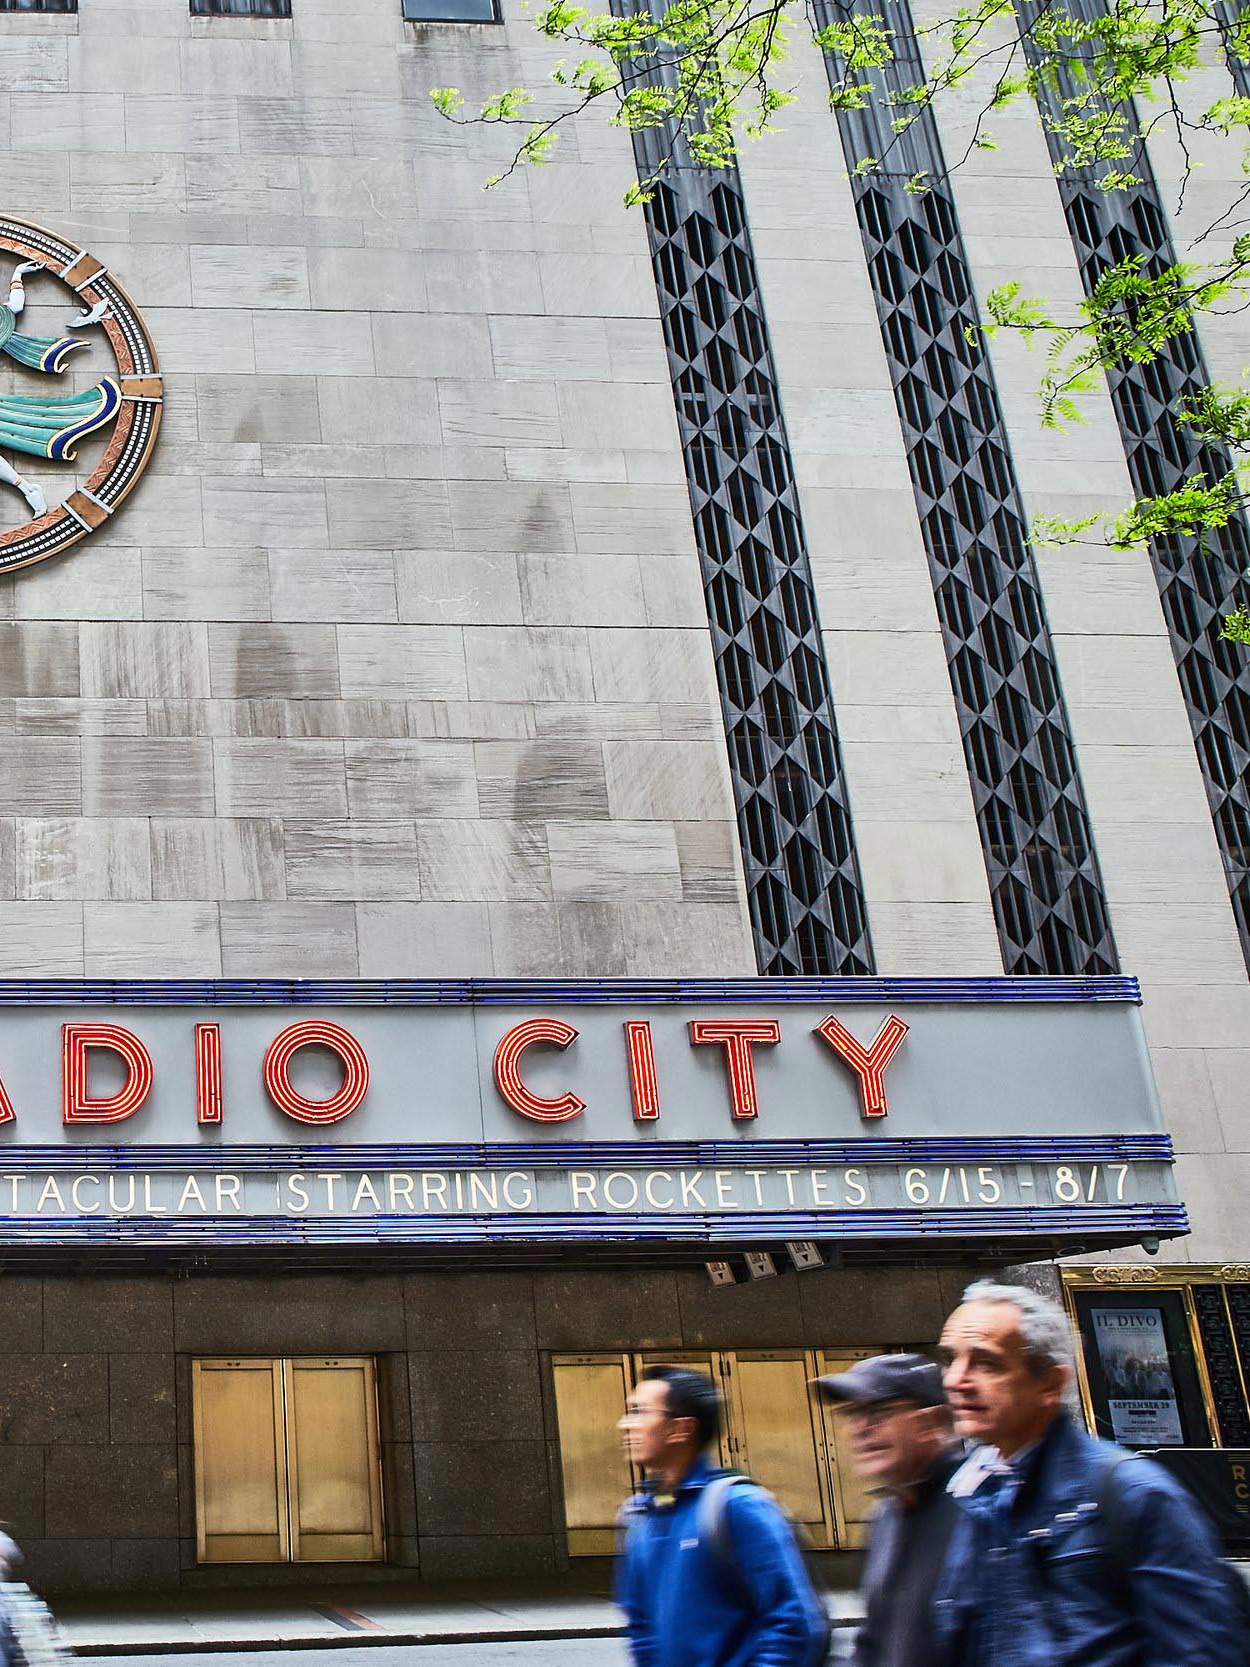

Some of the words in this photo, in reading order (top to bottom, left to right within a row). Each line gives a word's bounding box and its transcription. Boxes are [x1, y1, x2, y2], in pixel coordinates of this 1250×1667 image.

[494, 1014, 910, 1124] CITY
[286, 1172, 533, 1213] STARRING
[571, 1168, 867, 1211] ROCKETTES
[904, 1167, 1001, 1204] 6/15
[1054, 1164, 1129, 1202] 8/7
[1096, 1315, 1113, 1327] IL
[1117, 1315, 1158, 1327] DIVO
[1113, 1401, 1159, 1409] SEPTEMBER
